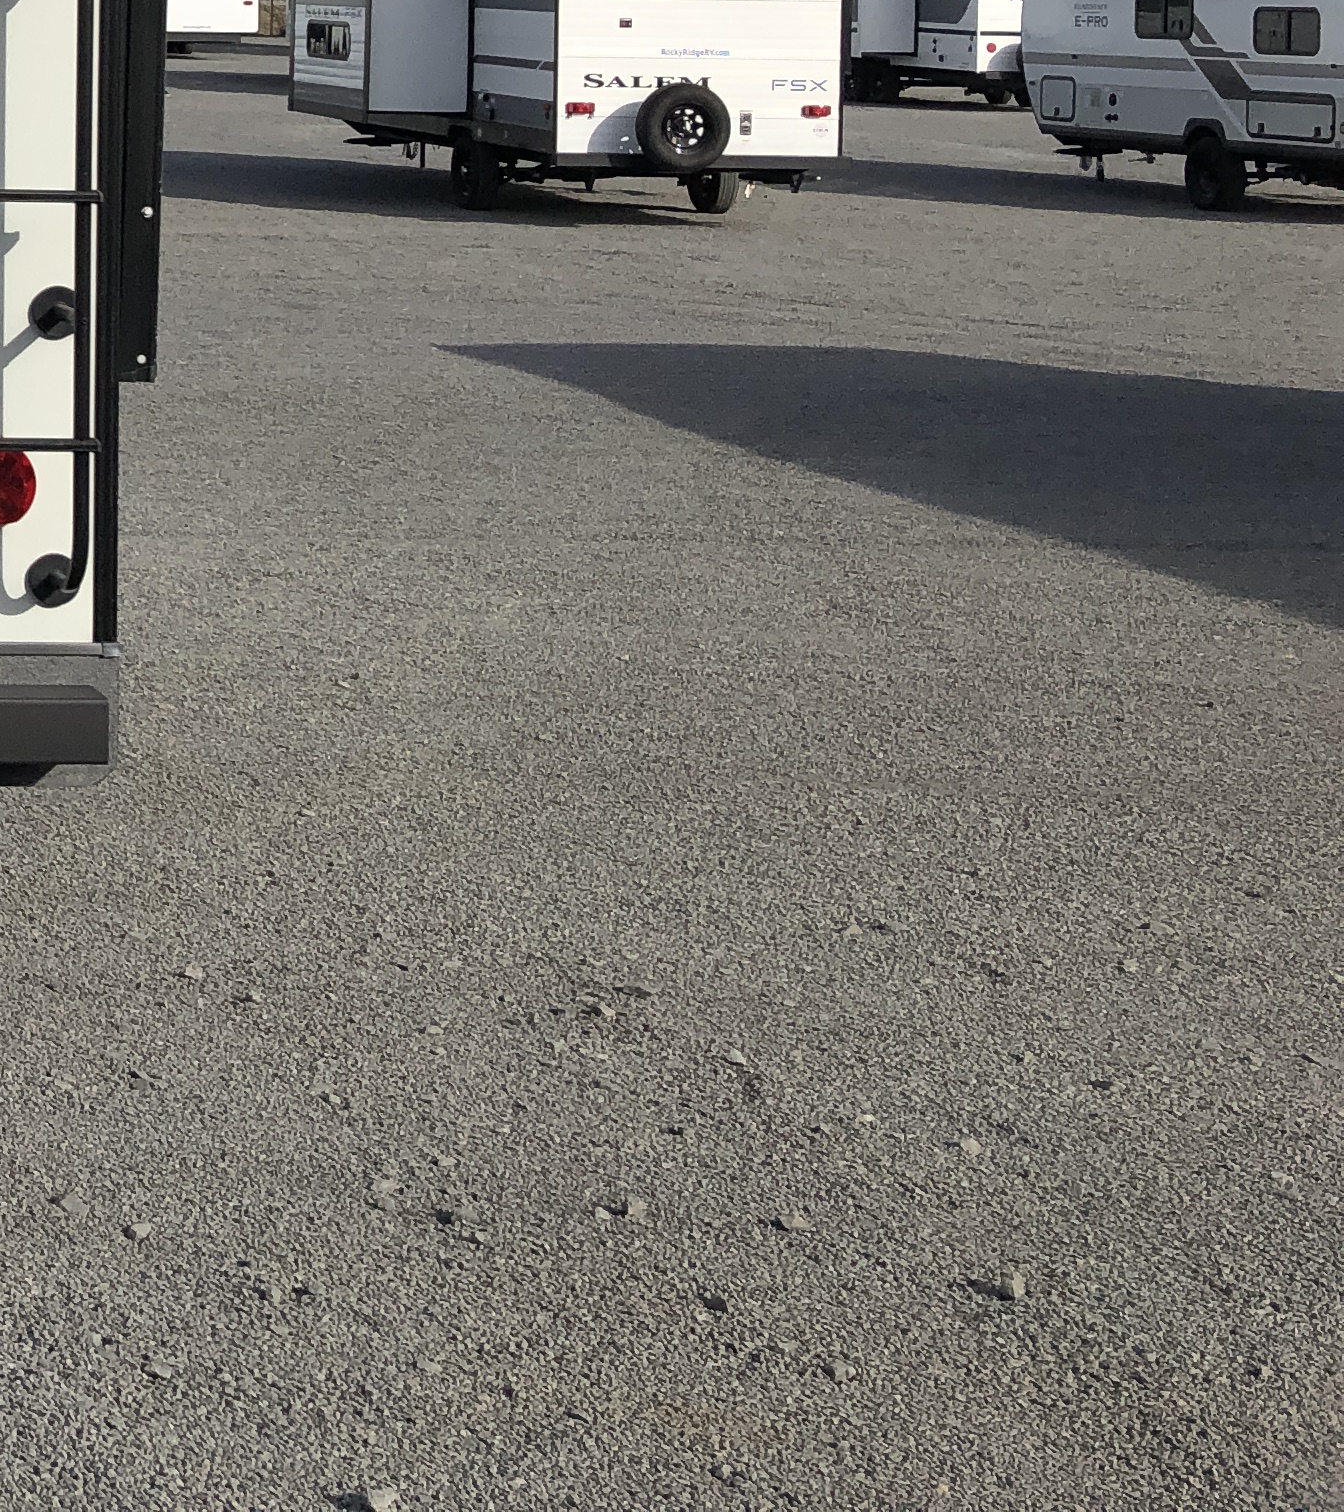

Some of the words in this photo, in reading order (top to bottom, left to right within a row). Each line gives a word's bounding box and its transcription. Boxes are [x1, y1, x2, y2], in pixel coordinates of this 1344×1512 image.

[1074, 15, 1109, 28] E-PRO
[583, 73, 712, 89] SALEM
[771, 79, 828, 92] FSX
